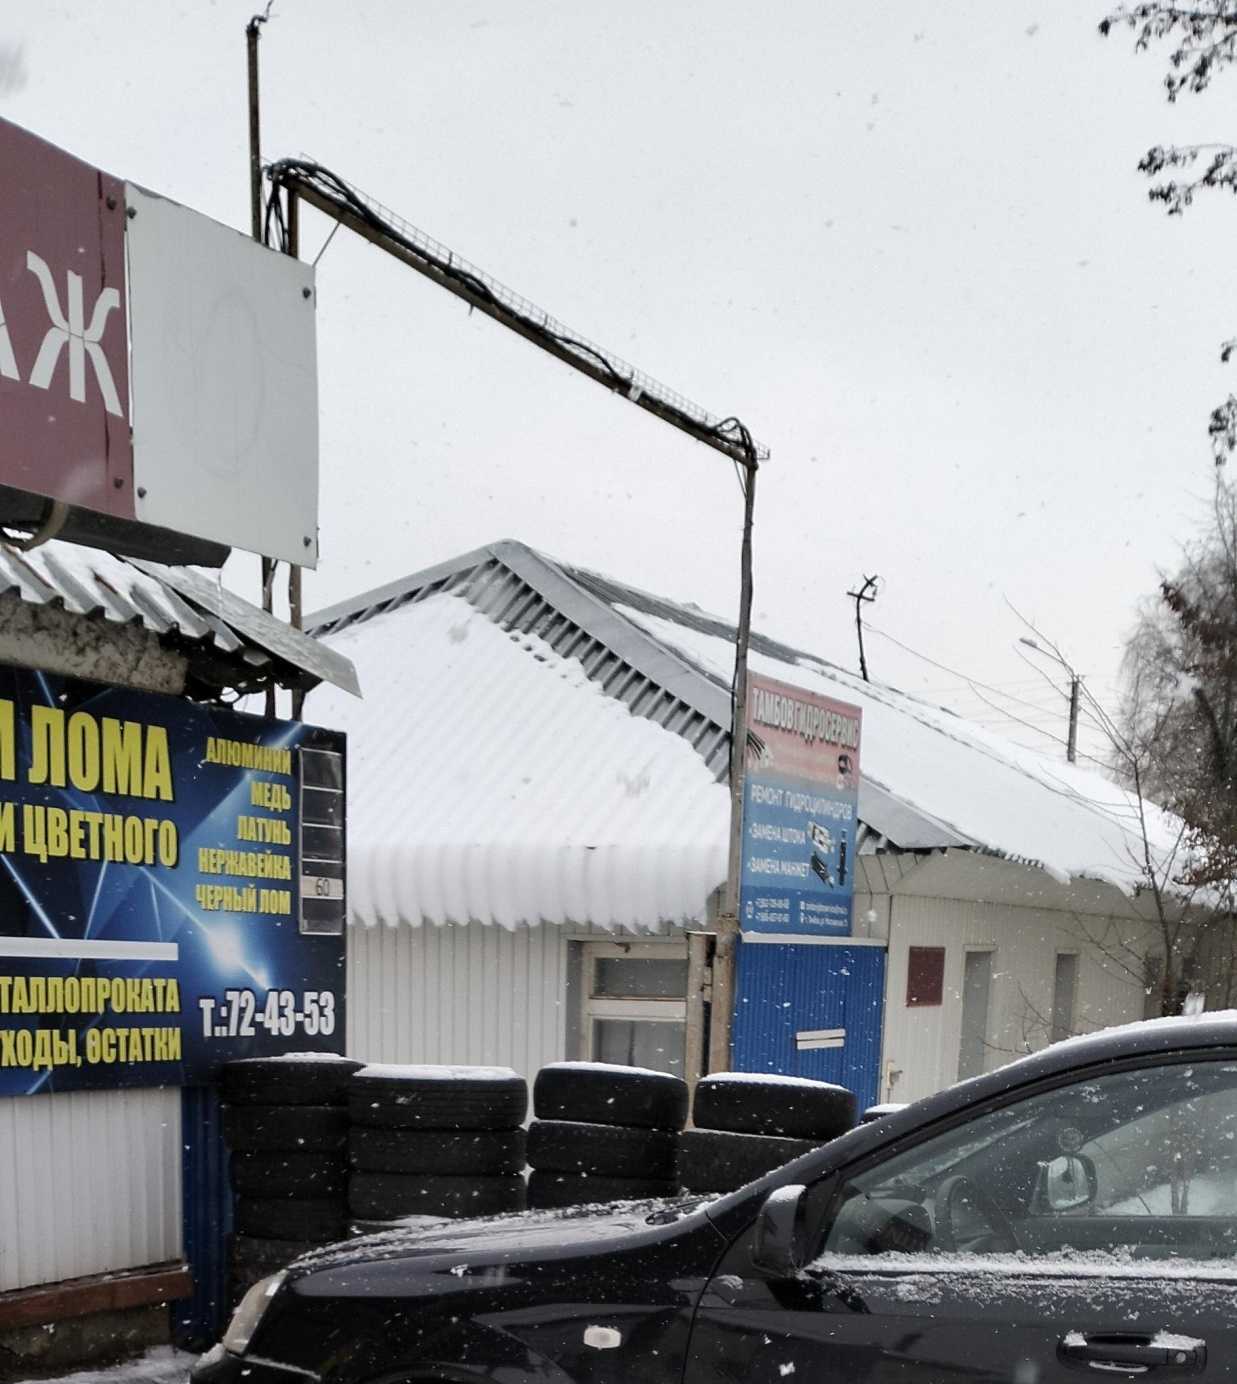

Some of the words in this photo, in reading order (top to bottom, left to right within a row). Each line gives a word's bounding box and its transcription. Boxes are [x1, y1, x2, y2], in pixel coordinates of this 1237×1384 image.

[28, 704, 174, 801] ЛОМА
[206, 736, 292, 776] АЛЮМИНИЙ
[251, 781, 292, 813] МЕДЬ
[23, 804, 178, 868] ЦВЕТНОГО
[237, 815, 292, 845] ЛАТУНЬ
[198, 847, 292, 881] НЕРЖАВЕЙКА
[195, 883, 258, 914] ЧЕРНЫЙ
[259, 888, 292, 916] ЛОМ
